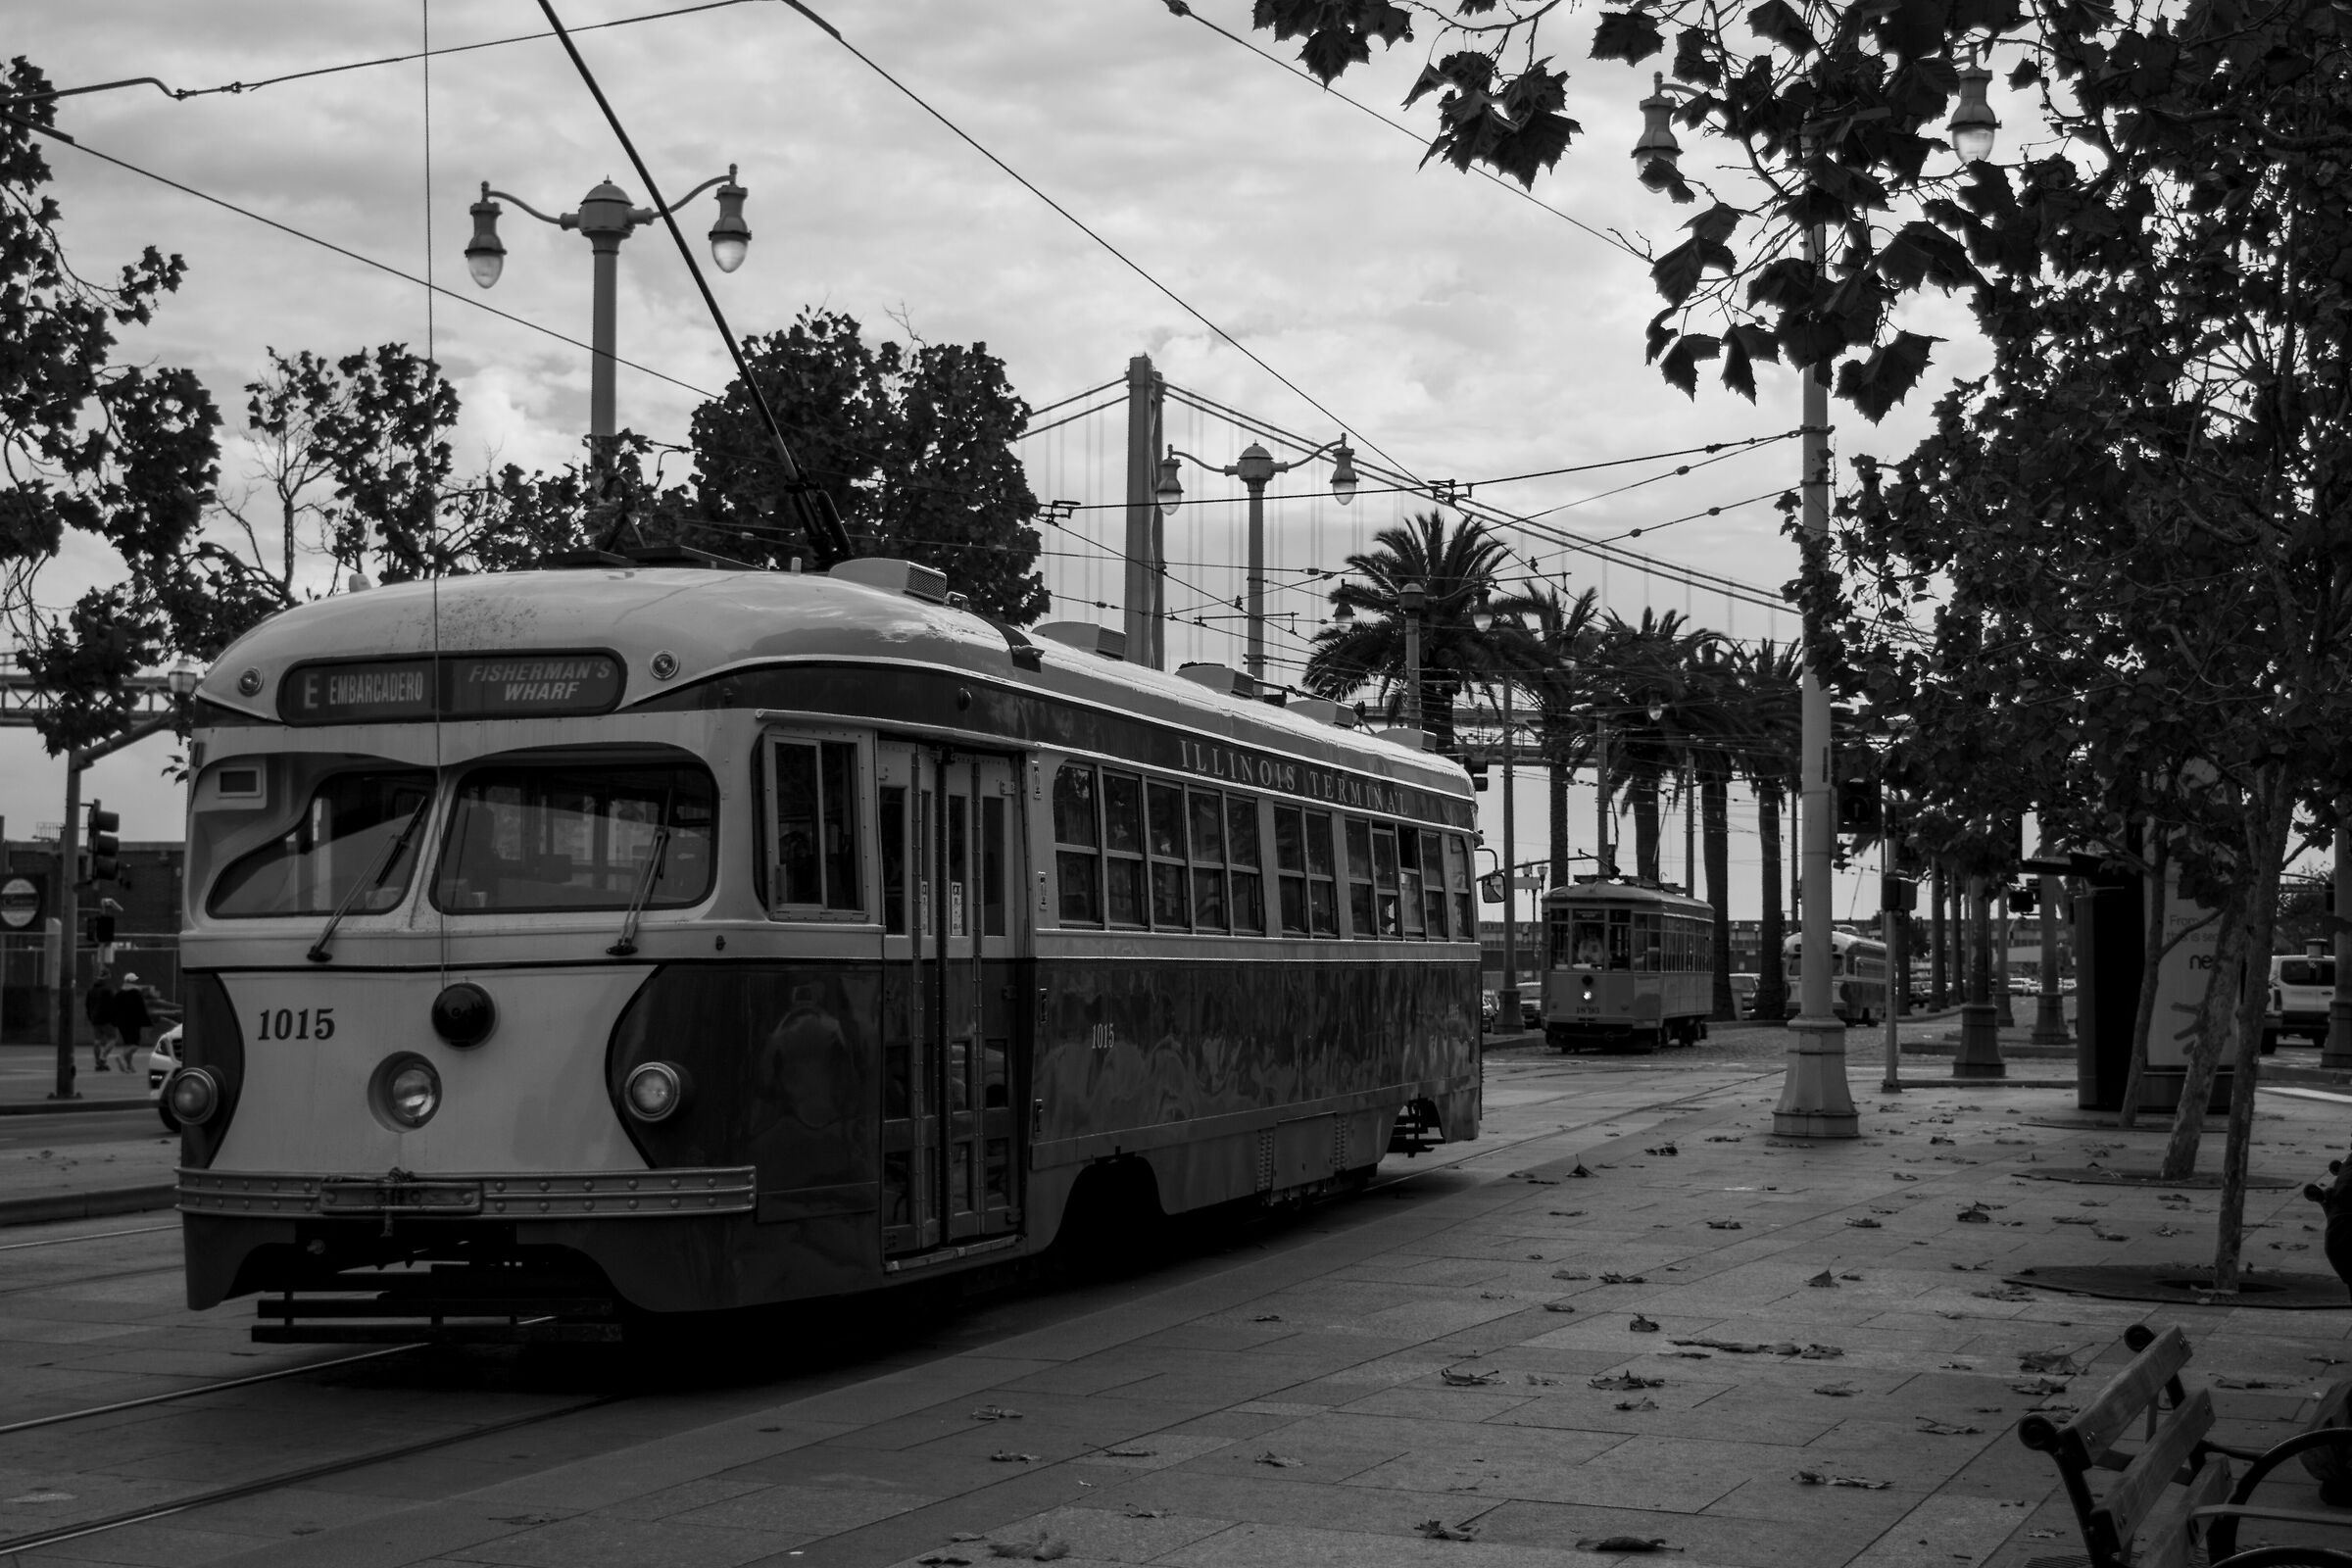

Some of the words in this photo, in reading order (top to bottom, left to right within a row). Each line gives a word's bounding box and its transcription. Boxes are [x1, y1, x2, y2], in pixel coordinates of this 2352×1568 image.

[468, 661, 612, 682] FISHERMAN'S
[304, 673, 318, 710] E
[329, 672, 423, 707] EMBARCADERO
[505, 681, 579, 702] WHARF
[1180, 740, 1296, 790] ILLINOIS
[1309, 770, 1408, 814] TERMINAL
[2189, 955, 2213, 969] ne
[258, 1008, 335, 1040] 1015
[1092, 1023, 1114, 1049] 1015
